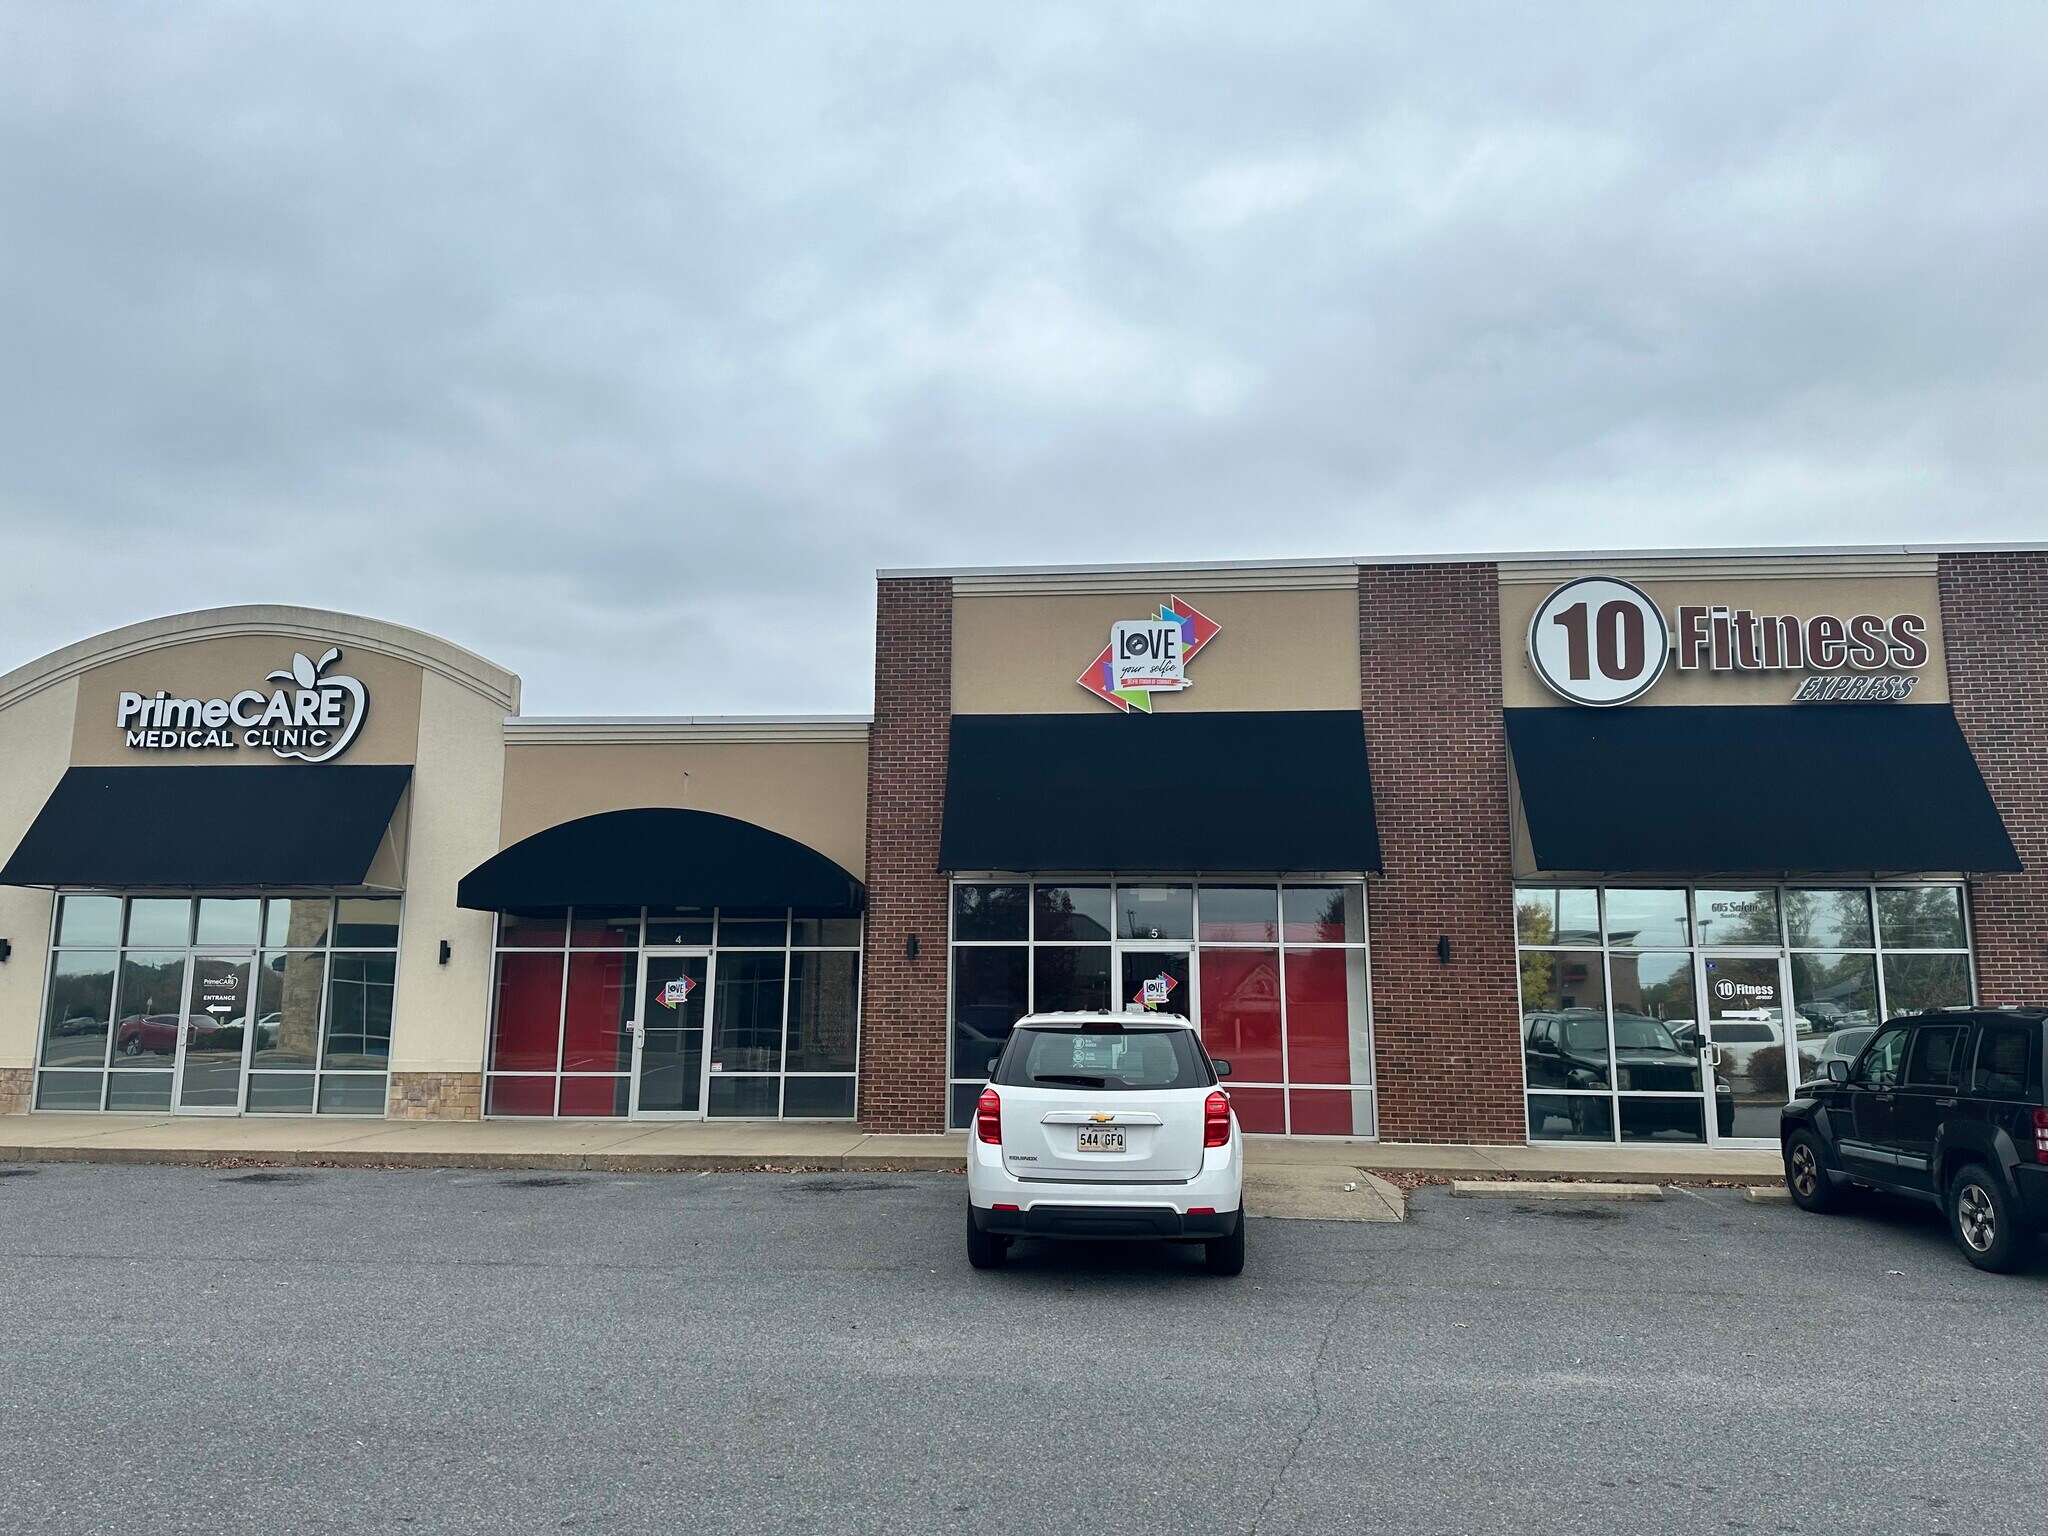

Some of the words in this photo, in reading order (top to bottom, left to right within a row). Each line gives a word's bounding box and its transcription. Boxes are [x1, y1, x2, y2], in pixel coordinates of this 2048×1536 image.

[1120, 629, 1176, 660] LOVE
[1553, 599, 1645, 681] 10
[1676, 604, 1929, 672] Fitness
[1120, 665, 1145, 679] your
[1150, 660, 1177, 677] selfie
[1793, 675, 1920, 702] EXPRESS
[116, 689, 344, 728] PrimeCARE
[125, 730, 236, 748] MEDICAL
[243, 729, 329, 747] CLINIC
[1711, 902, 1728, 912] 605
[1729, 901, 1758, 912] Salem
[675, 935, 682, 944] 4
[1151, 928, 1158, 938] 5
[668, 984, 684, 994] LOVE
[1146, 982, 1164, 993] LOVE
[1718, 982, 1733, 996] 10
[1736, 983, 1774, 995] Fitness
[1080, 1133, 1098, 1146] 544
[1104, 1133, 1123, 1146] GFQ
